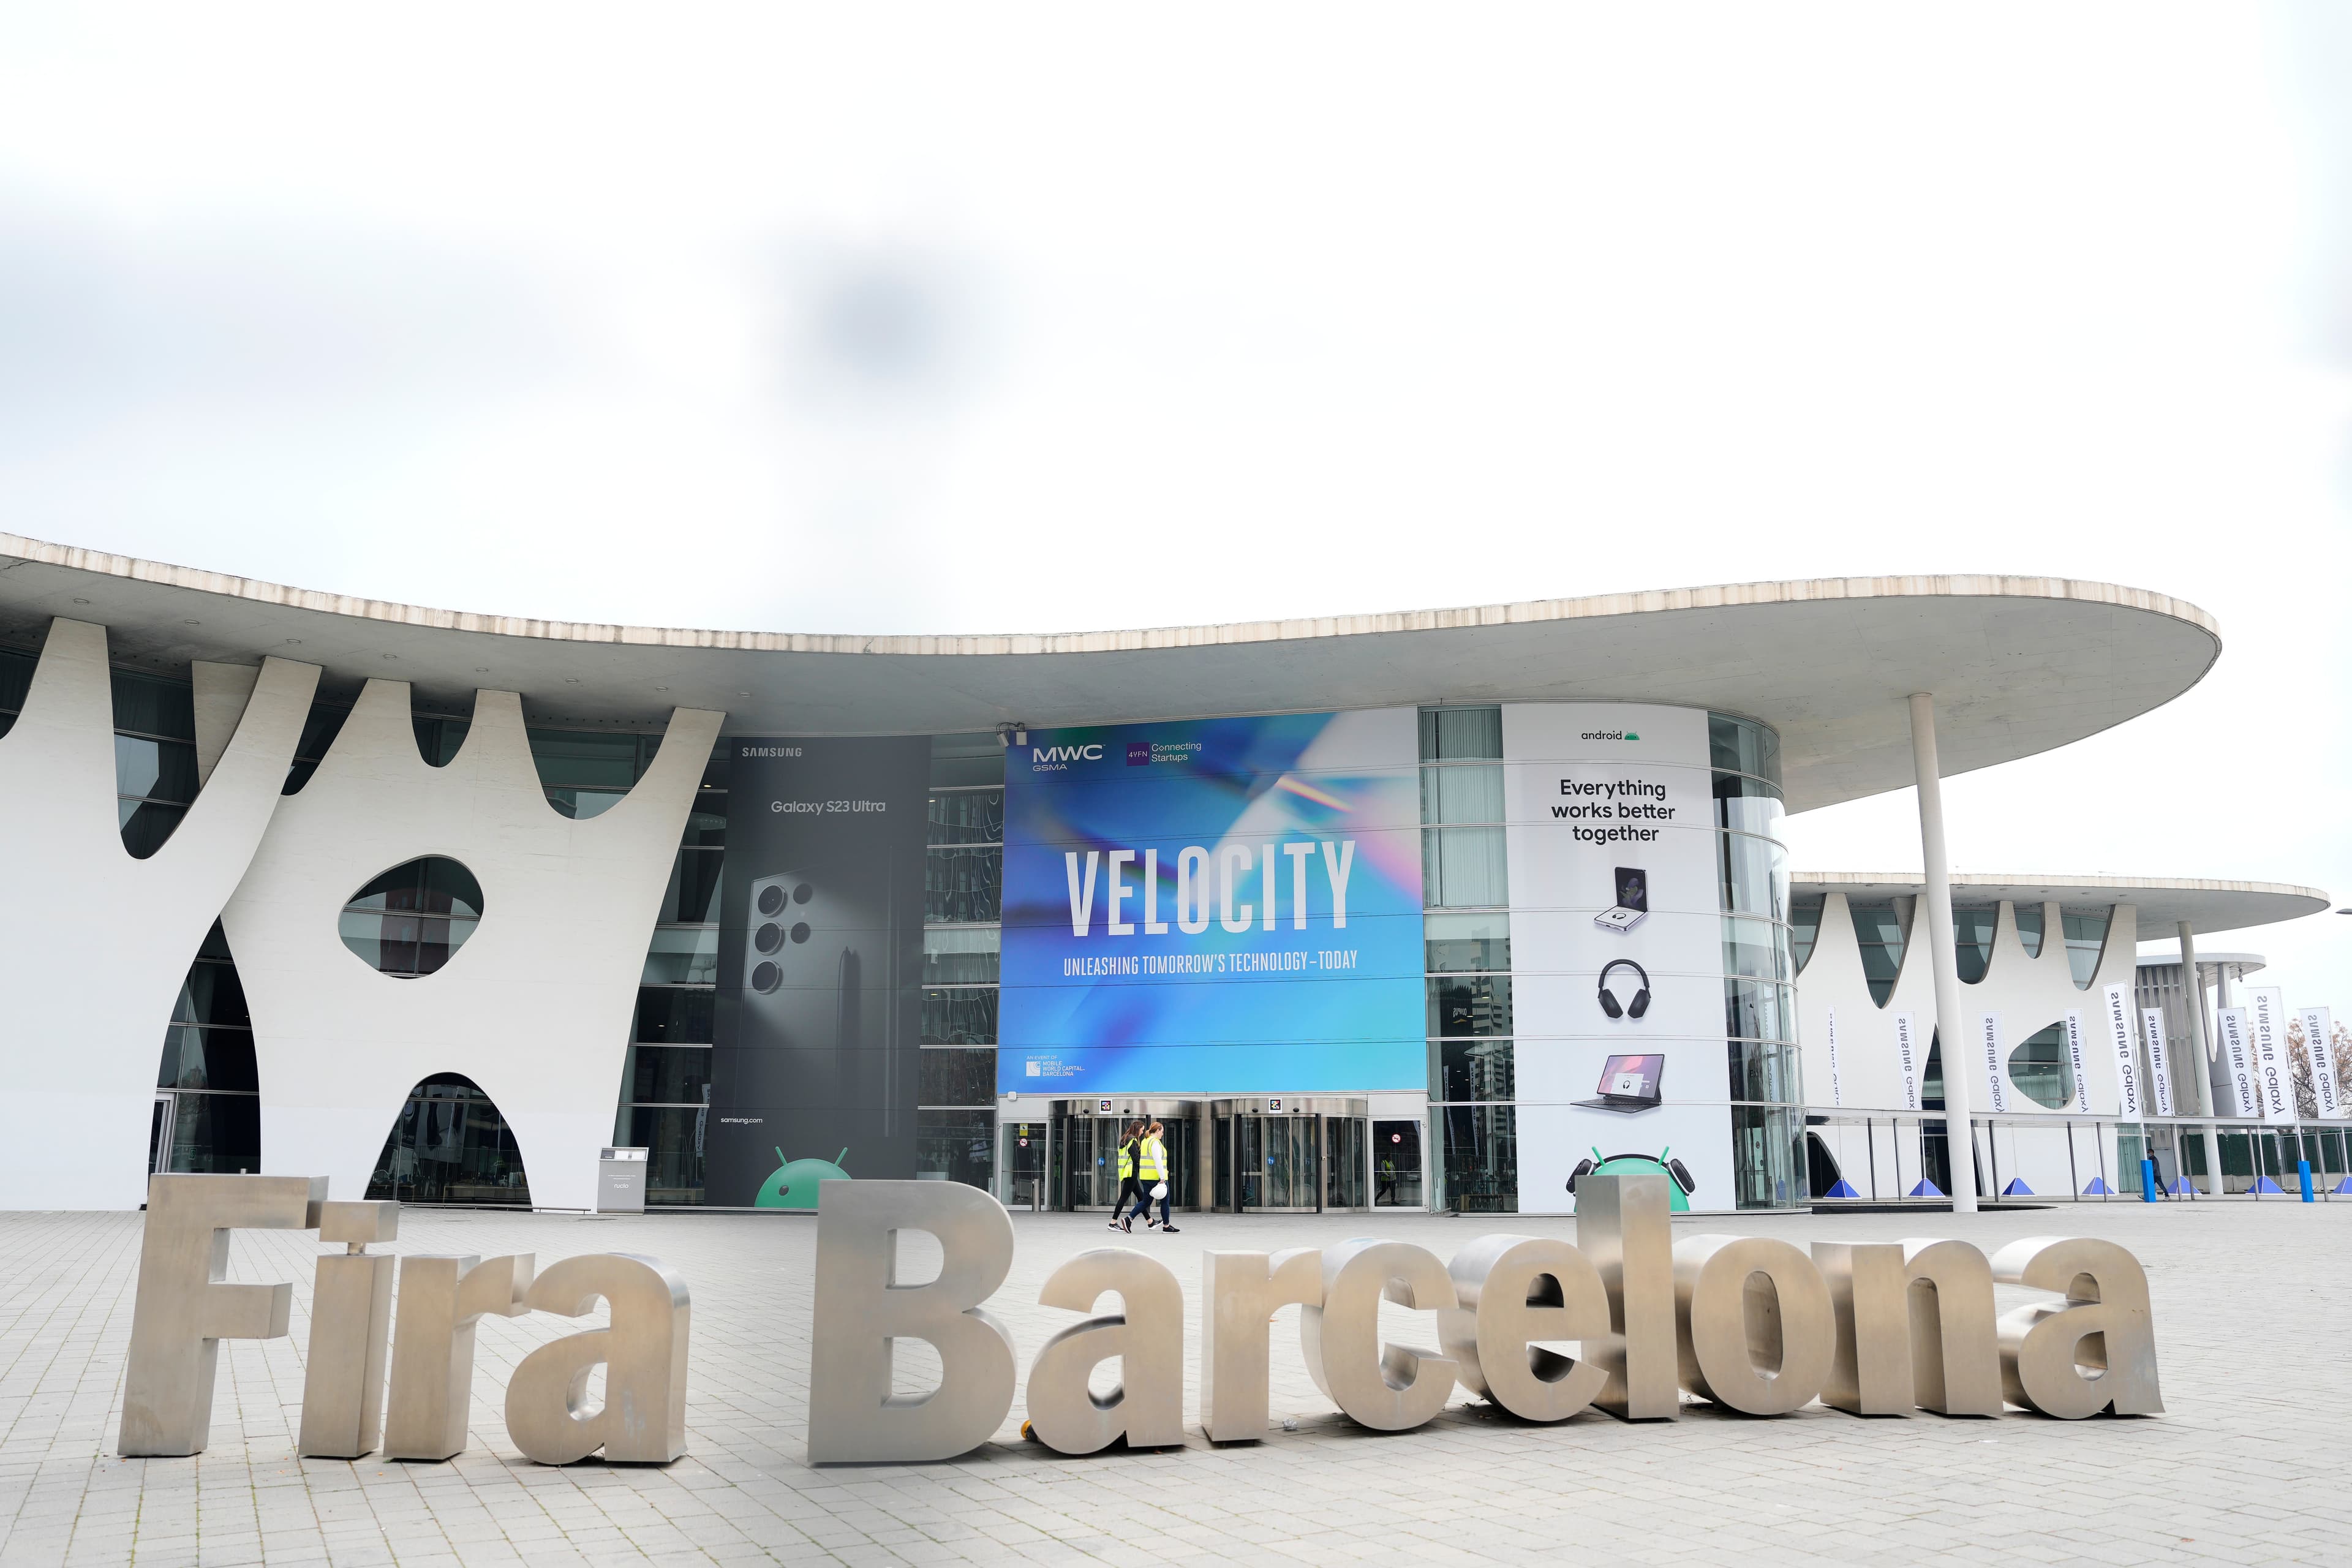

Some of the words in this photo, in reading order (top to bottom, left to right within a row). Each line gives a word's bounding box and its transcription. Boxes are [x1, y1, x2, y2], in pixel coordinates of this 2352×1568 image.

[1581, 730, 1622, 740] android
[742, 747, 802, 757] SAMSUNG
[1152, 742, 1202, 753] Connecting
[1152, 753, 1188, 763] Startups
[1560, 779, 1666, 801] Everything
[771, 801, 824, 815] Galaxy
[826, 801, 850, 813] S23
[852, 800, 886, 812] Ultra
[1551, 802, 1613, 818] works
[1618, 802, 1676, 820] better
[1572, 824, 1659, 845] together
[1065, 840, 1356, 937] VELOCITY
[1064, 956, 1139, 976] UNLEASHING
[1142, 953, 1226, 974] TOMORROW'S
[118, 1173, 691, 1466] Fira
[808, 1175, 2165, 1463] Barcelona
